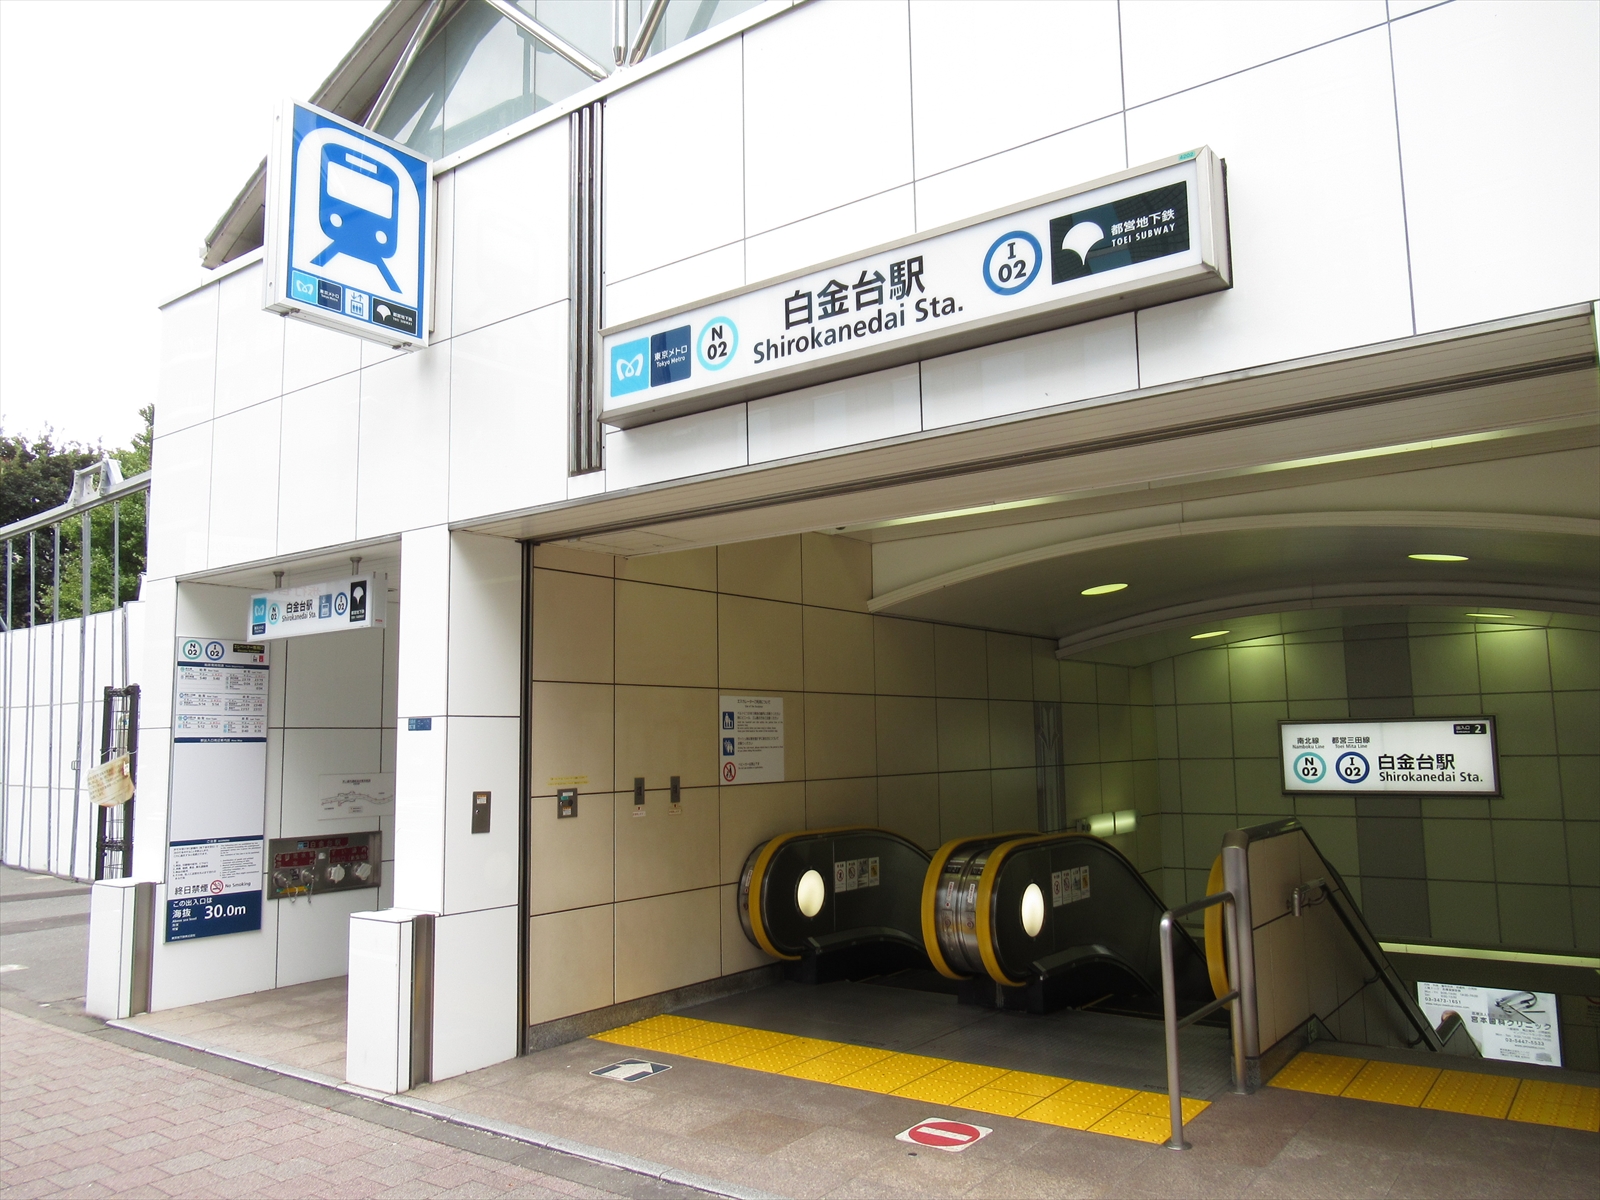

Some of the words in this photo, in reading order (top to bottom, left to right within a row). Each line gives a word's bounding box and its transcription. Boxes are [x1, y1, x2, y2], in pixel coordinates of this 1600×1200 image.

[1111, 208, 1176, 236] 都営地下鉄
[1111, 235, 1132, 248] TOEI
[1135, 222, 1176, 242] SUBWAY
[1007, 242, 1016, 260] I
[998, 259, 1026, 283] 02
[784, 255, 926, 330] 白金台駅
[711, 325, 723, 340] N
[753, 306, 906, 364] Shirokanedai
[914, 293, 964, 322] Sta.
[654, 345, 688, 361] 東京メトロ
[706, 342, 728, 361] 02
[656, 358, 671, 368] Tokyo
[670, 355, 686, 364] Metro
[286, 599, 313, 614] 白金台駅
[337, 602, 345, 611] 02
[270, 613, 277, 621] 02
[281, 611, 308, 623] Shirokanedai
[187, 648, 197, 656] 02
[1474, 724, 1482, 734] 2
[1331, 736, 1370, 744] 都営三田線
[1304, 757, 1314, 766] N
[1349, 757, 1355, 766] I
[1378, 753, 1456, 771] 白金台駅
[1301, 766, 1318, 777] 02
[1344, 766, 1361, 777] 02
[1379, 771, 1456, 782] Shirokanedai
[1460, 771, 1483, 782] Sta.
[174, 883, 209, 896] 終日禁煙
[232, 881, 251, 889] Smoking
[173, 897, 213, 908] この出入口は
[172, 908, 191, 919] 海抜
[204, 904, 246, 919] 30.0m
[1471, 1016, 1552, 1030] 宮本歯科クリニック
